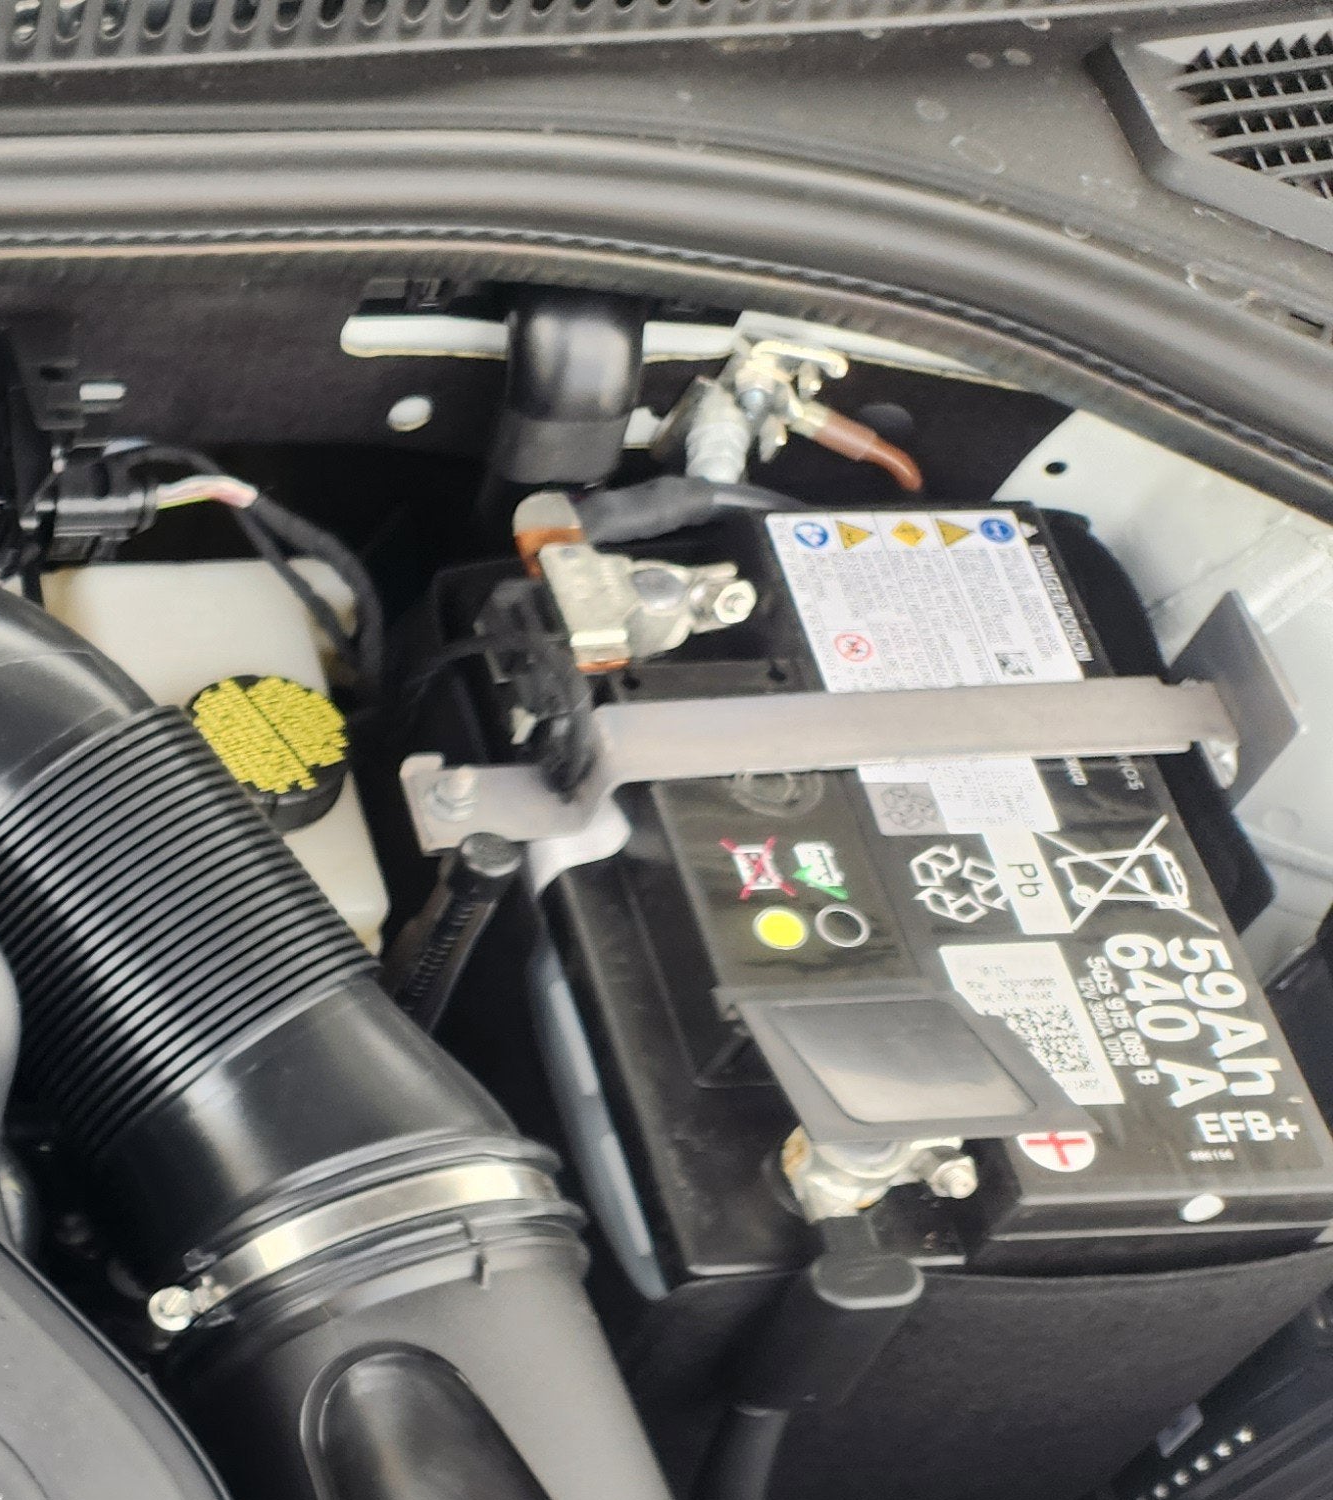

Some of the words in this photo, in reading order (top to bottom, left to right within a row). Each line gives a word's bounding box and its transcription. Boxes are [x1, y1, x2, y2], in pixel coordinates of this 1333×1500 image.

[1007, 862, 1041, 899] Pb
[1104, 933, 1200, 1042] 640
[1155, 1058, 1227, 1108] A
[1105, 997, 1134, 1030] 915
[1136, 1068, 1160, 1087] B
[1167, 937, 1282, 1097] 59Ah
[1195, 1110, 1300, 1144] EFB+
